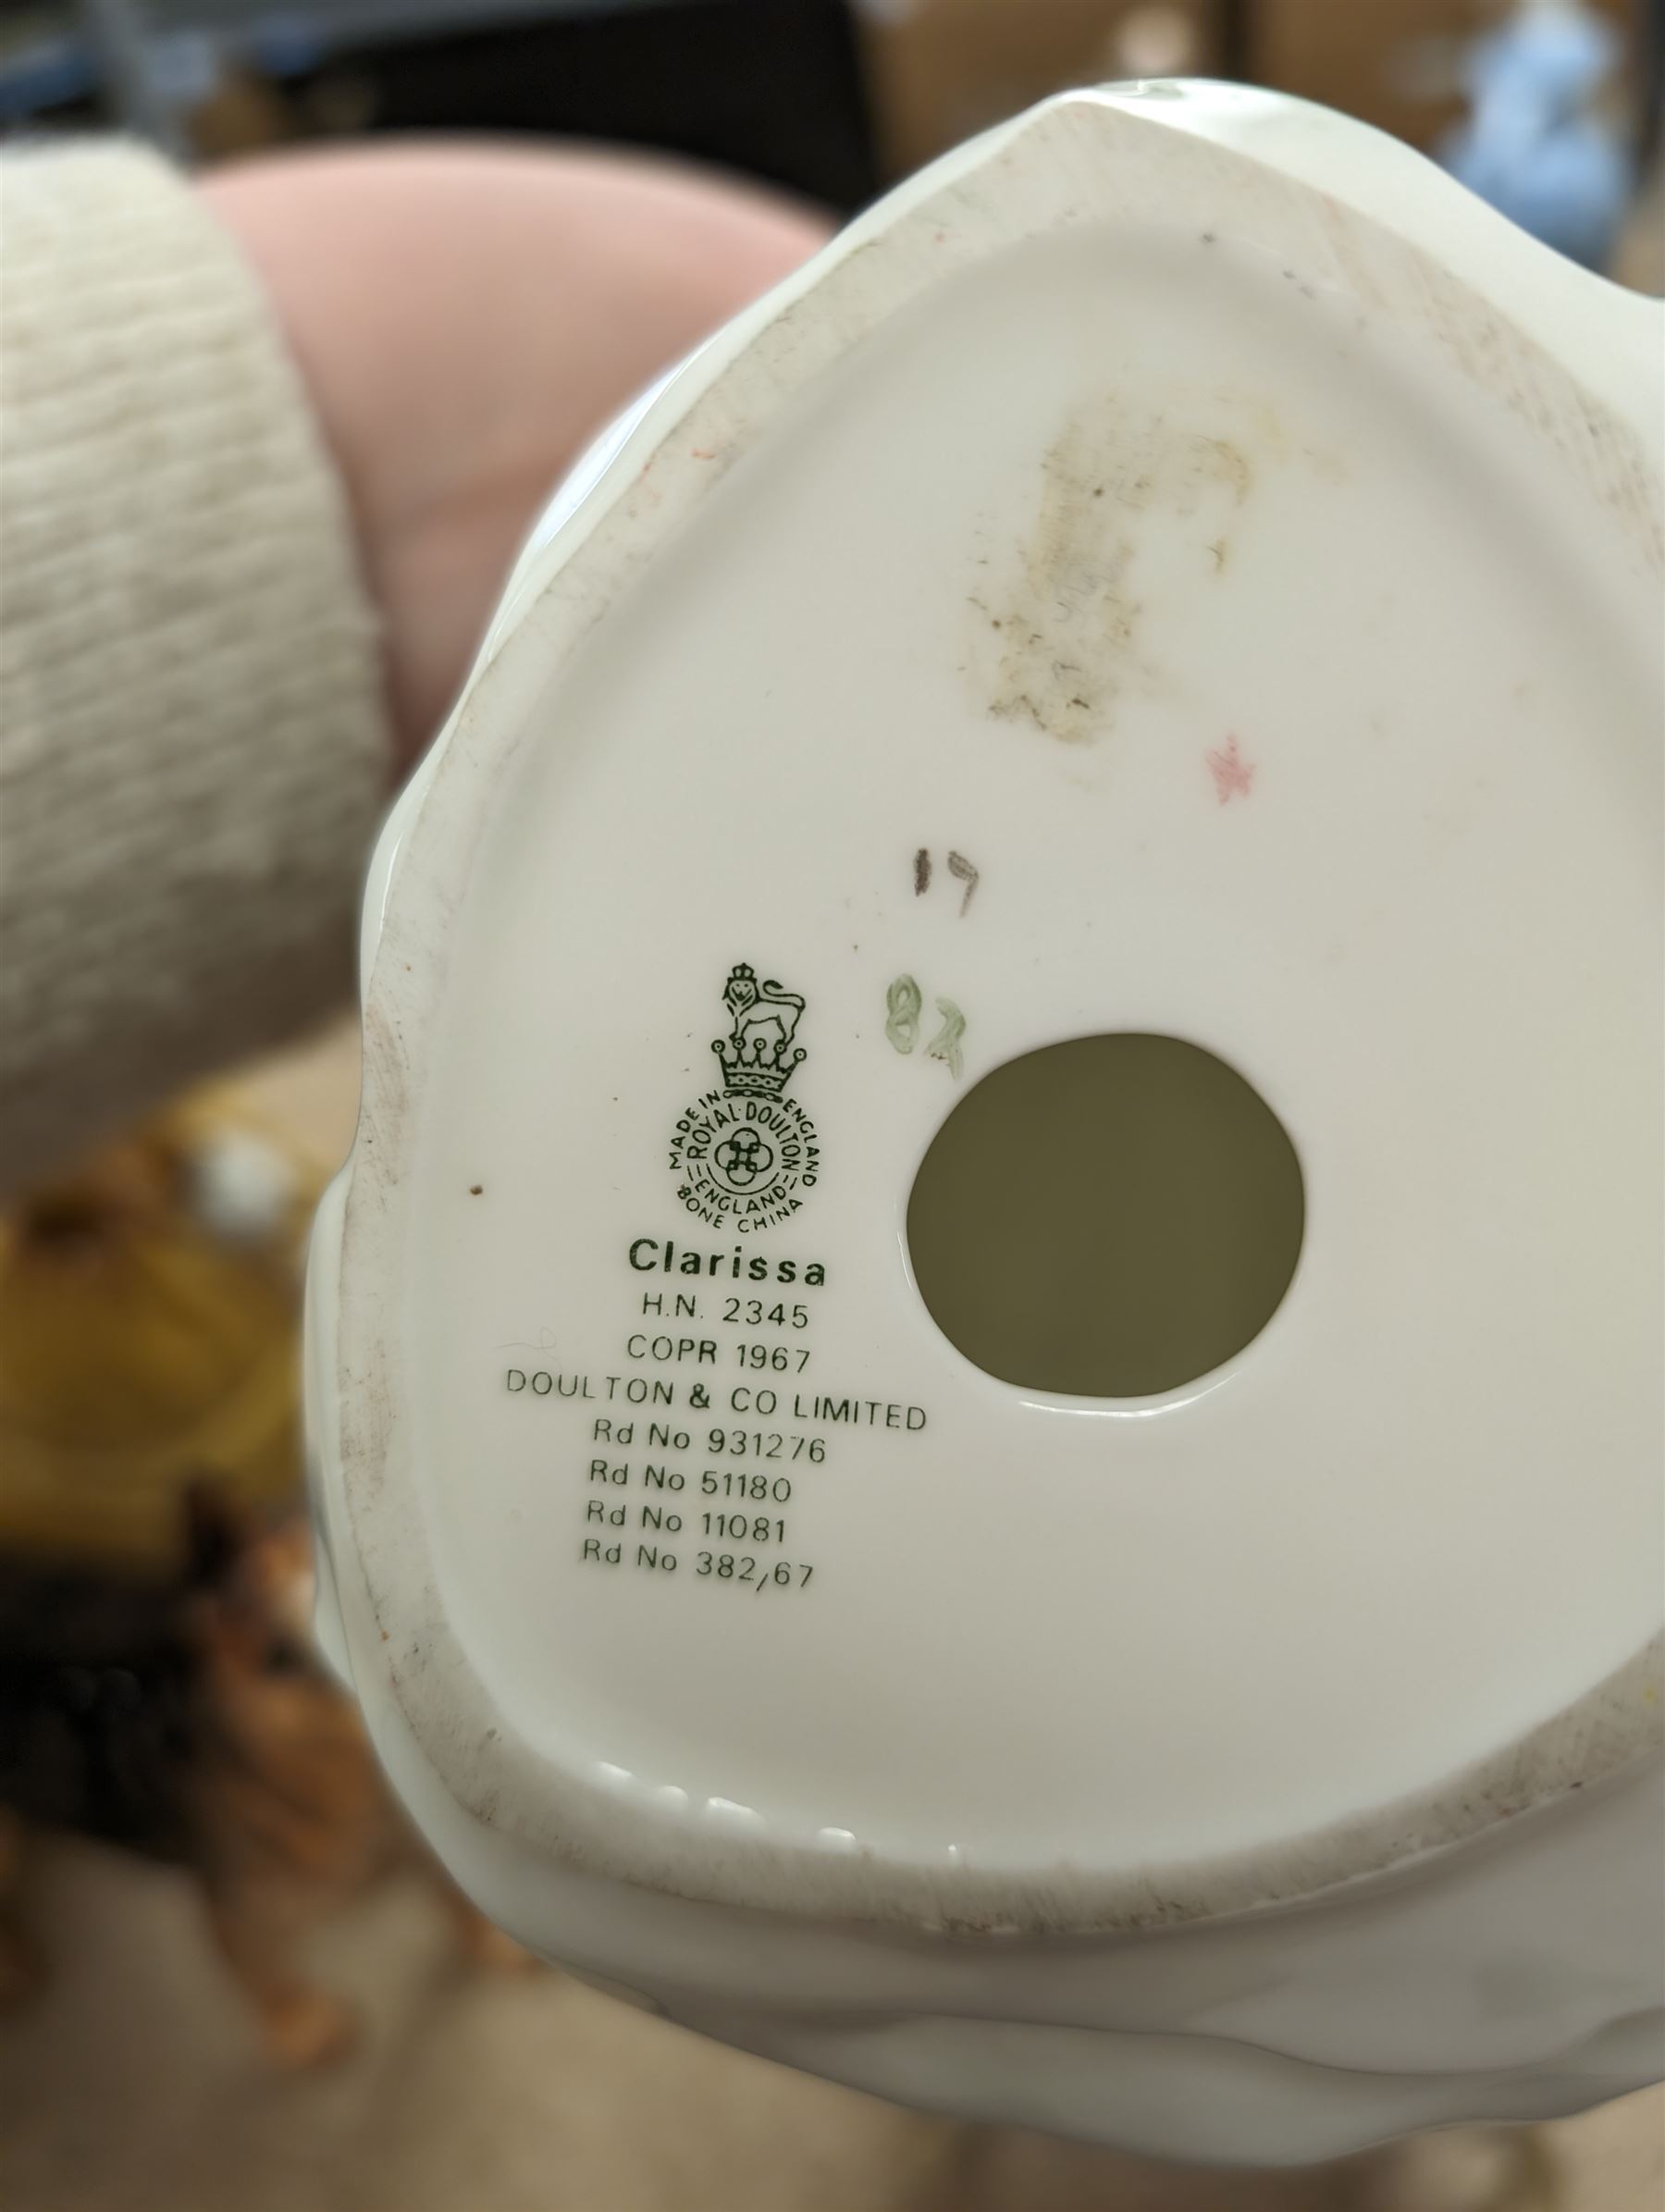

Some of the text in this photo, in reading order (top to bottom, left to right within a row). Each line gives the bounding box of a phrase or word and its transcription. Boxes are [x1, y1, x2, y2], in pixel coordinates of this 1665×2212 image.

[669, 1089, 820, 1187] MADE IN ENGLAND
[677, 1184, 803, 1233] BONE CHINA
[629, 1238, 826, 1286] Clarissa
[643, 1292, 808, 1328] H.N. 2345
[627, 1335, 810, 1373] COPR 1967
[507, 1369, 926, 1430] DOULTON & CO LIMITED
[593, 1418, 827, 1464] Rd No 931276
[589, 1459, 792, 1503] Rd No 51180
[586, 1500, 785, 1543] Rd No 11081
[583, 1539, 623, 1564] Rd
[637, 1544, 677, 1572] No
